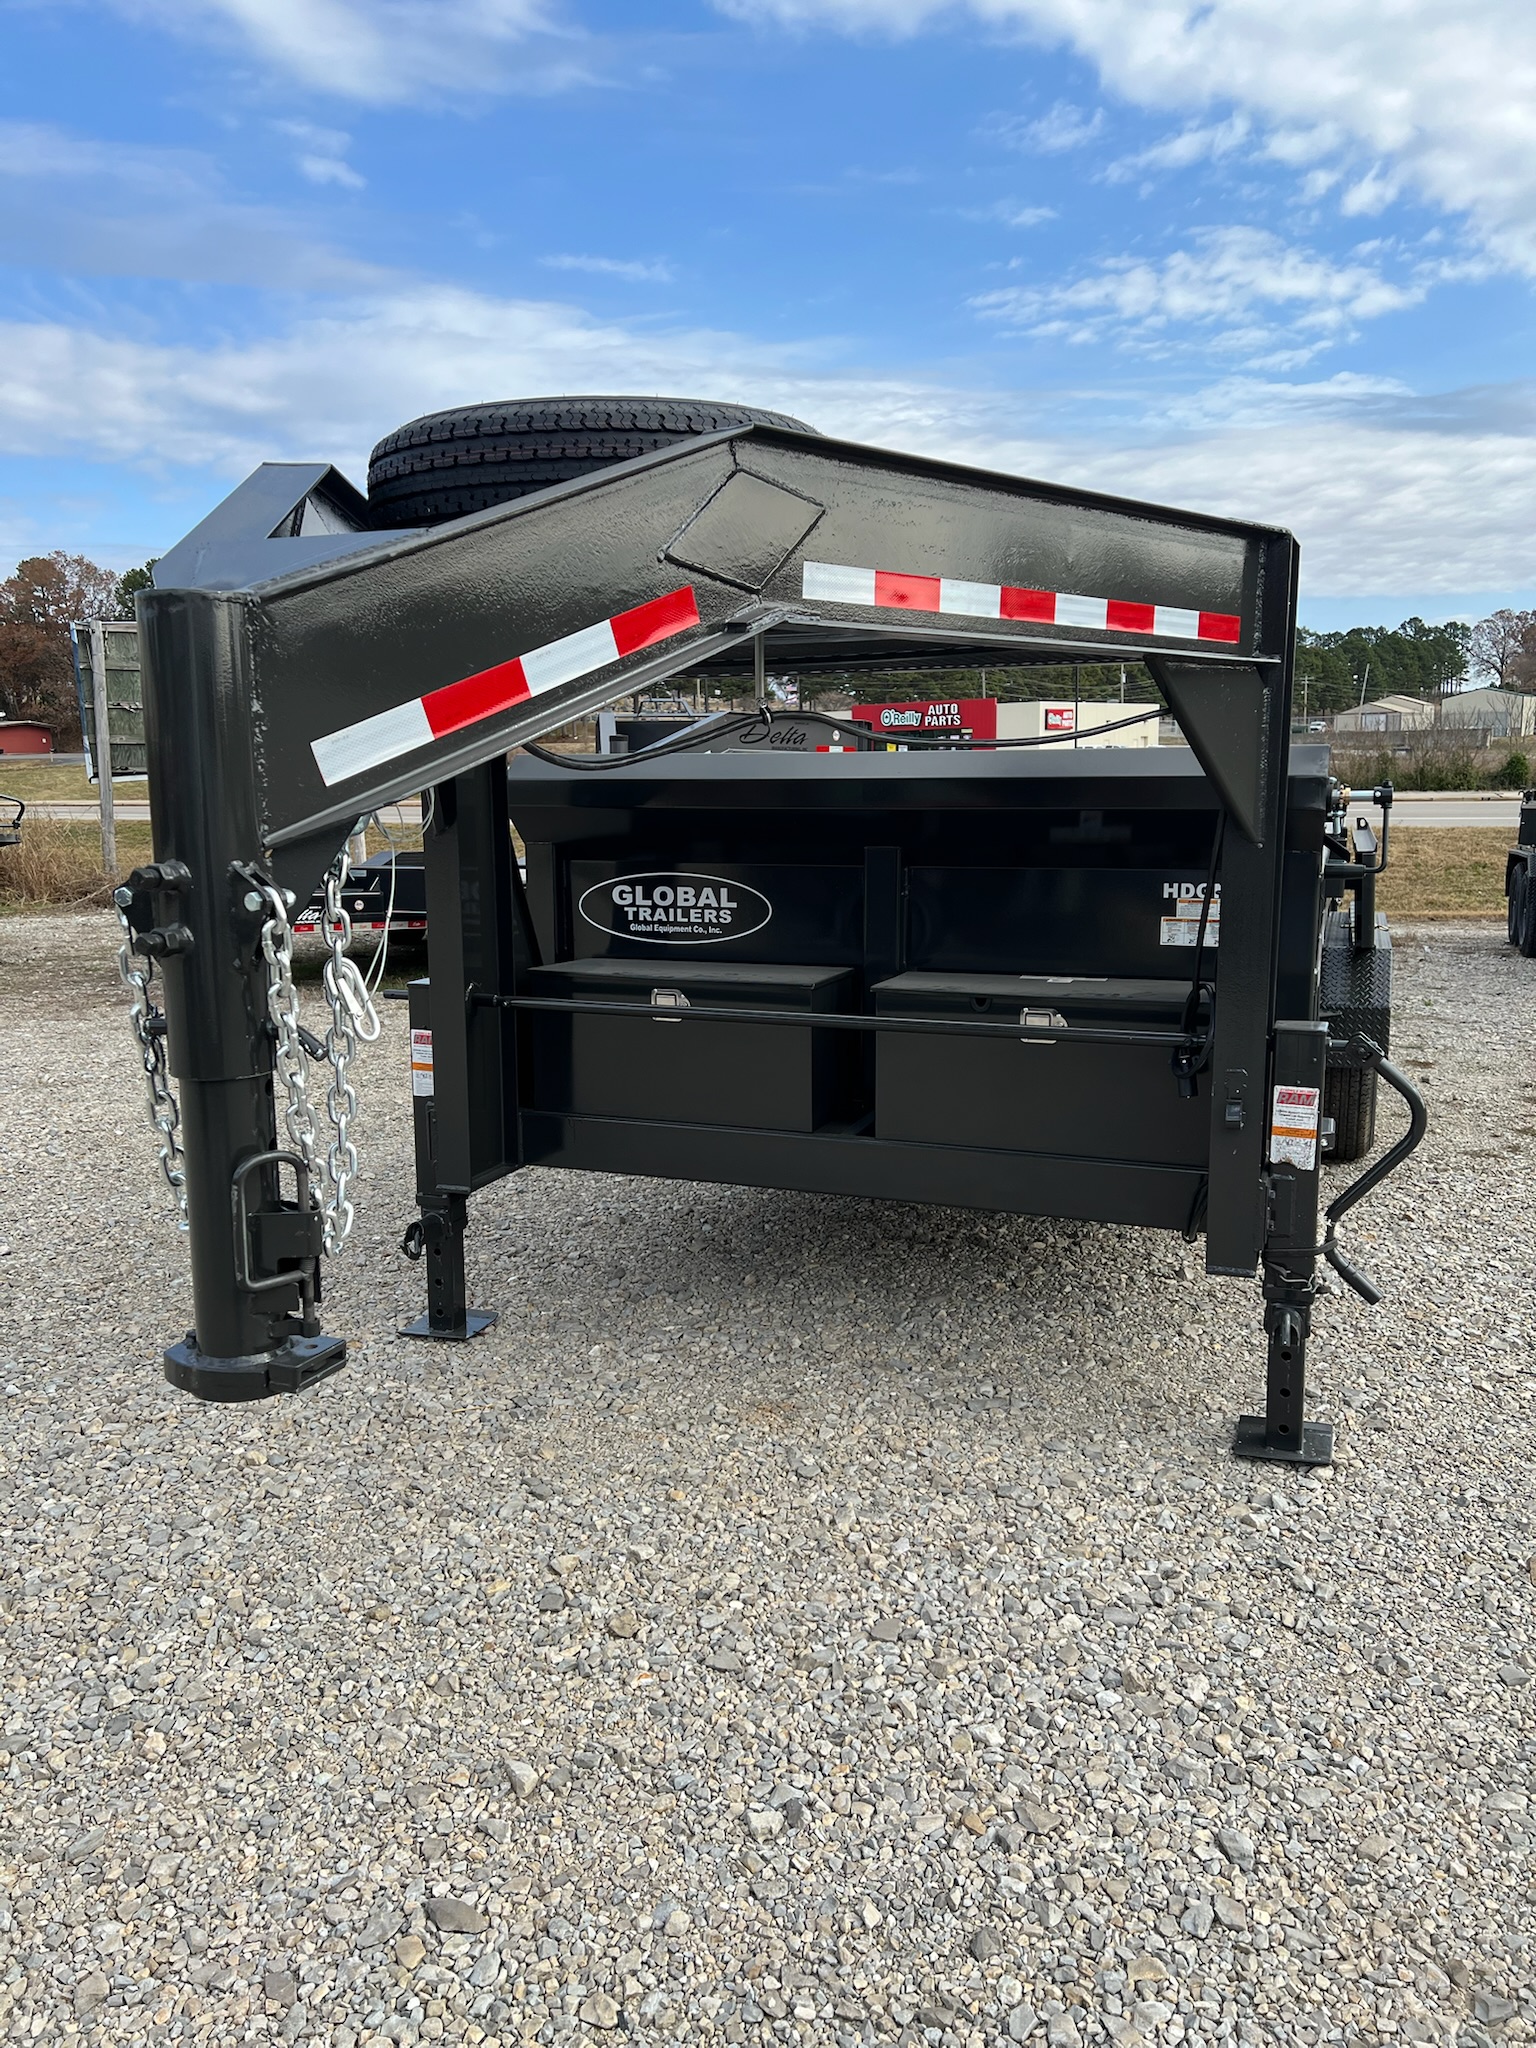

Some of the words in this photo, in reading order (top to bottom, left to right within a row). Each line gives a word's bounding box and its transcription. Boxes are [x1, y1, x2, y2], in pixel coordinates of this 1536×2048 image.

[927, 703, 959, 716] AUTO
[881, 708, 922, 727] O'Reilly
[924, 714, 961, 726] PARTS
[739, 724, 808, 746] Delta
[611, 885, 738, 909] GLOBAL
[624, 907, 732, 924] TRAILERS
[630, 923, 653, 932] Global
[654, 924, 692, 934] Equipment
[708, 926, 723, 934] Inc.
[414, 1035, 433, 1045] RA
[1277, 1092, 1316, 1106] RAM
